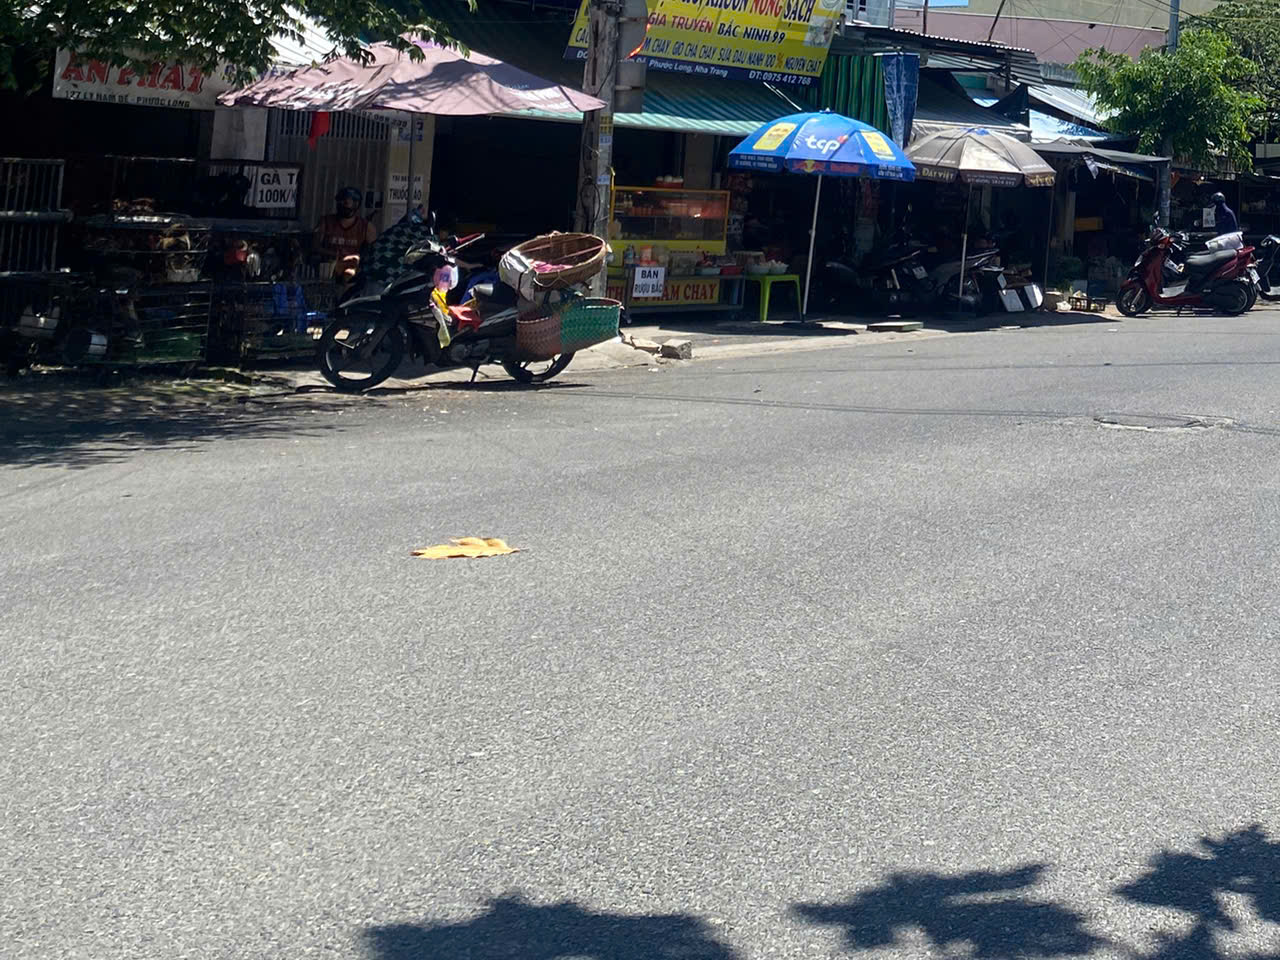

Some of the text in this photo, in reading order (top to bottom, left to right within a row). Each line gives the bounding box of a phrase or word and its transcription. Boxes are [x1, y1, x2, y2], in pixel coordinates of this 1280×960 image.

[647, 12, 667, 26] GIA
[743, 26, 771, 41] NINH
[772, 31, 786, 44] 99
[694, 65, 708, 74] Nha
[709, 67, 728, 78] Trang
[805, 135, 840, 154] tcp
[261, 169, 281, 185] GÀ
